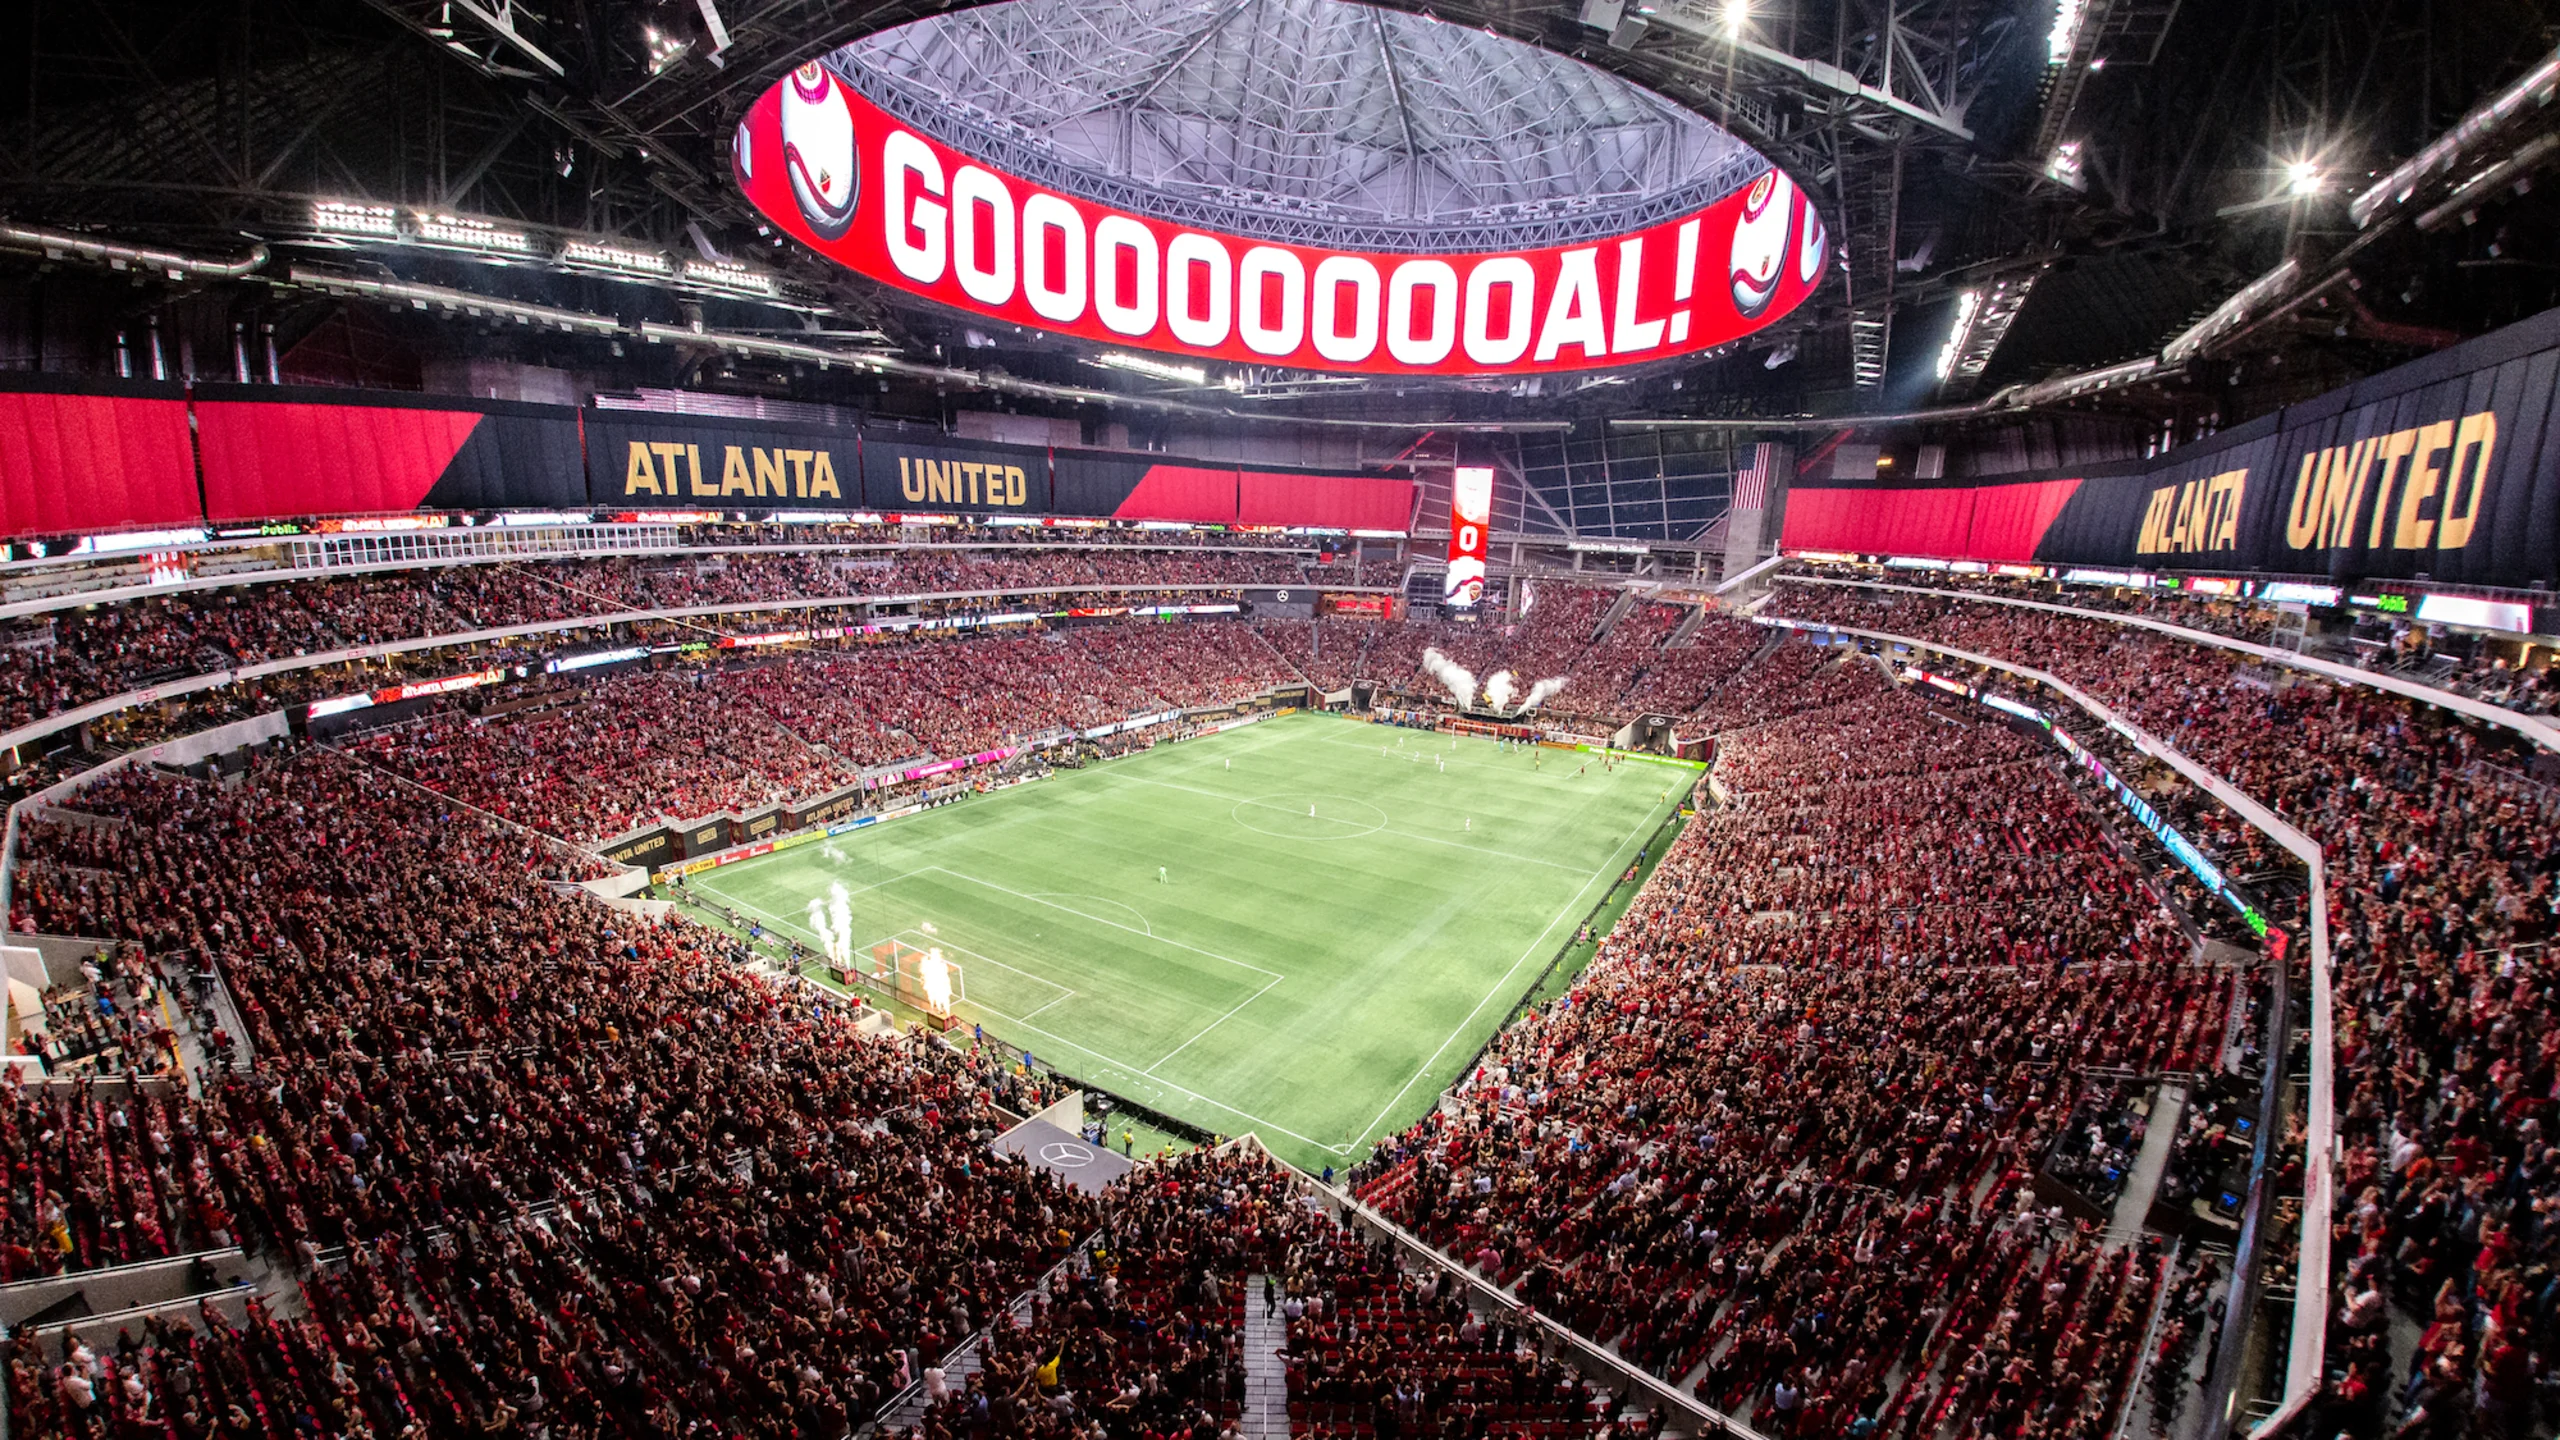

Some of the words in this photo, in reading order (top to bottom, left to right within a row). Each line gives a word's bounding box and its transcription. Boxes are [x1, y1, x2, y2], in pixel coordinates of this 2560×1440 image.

[884, 130, 1701, 364] GOOOOOOOOAL!
[625, 441, 841, 499] ATLANTA
[899, 457, 1026, 506] UNITED
[2136, 468, 2250, 554] ATLANTA
[2287, 411, 2497, 551] UNITED
[1459, 525, 1478, 552] 0
[634, 836, 665, 855] UNITED
